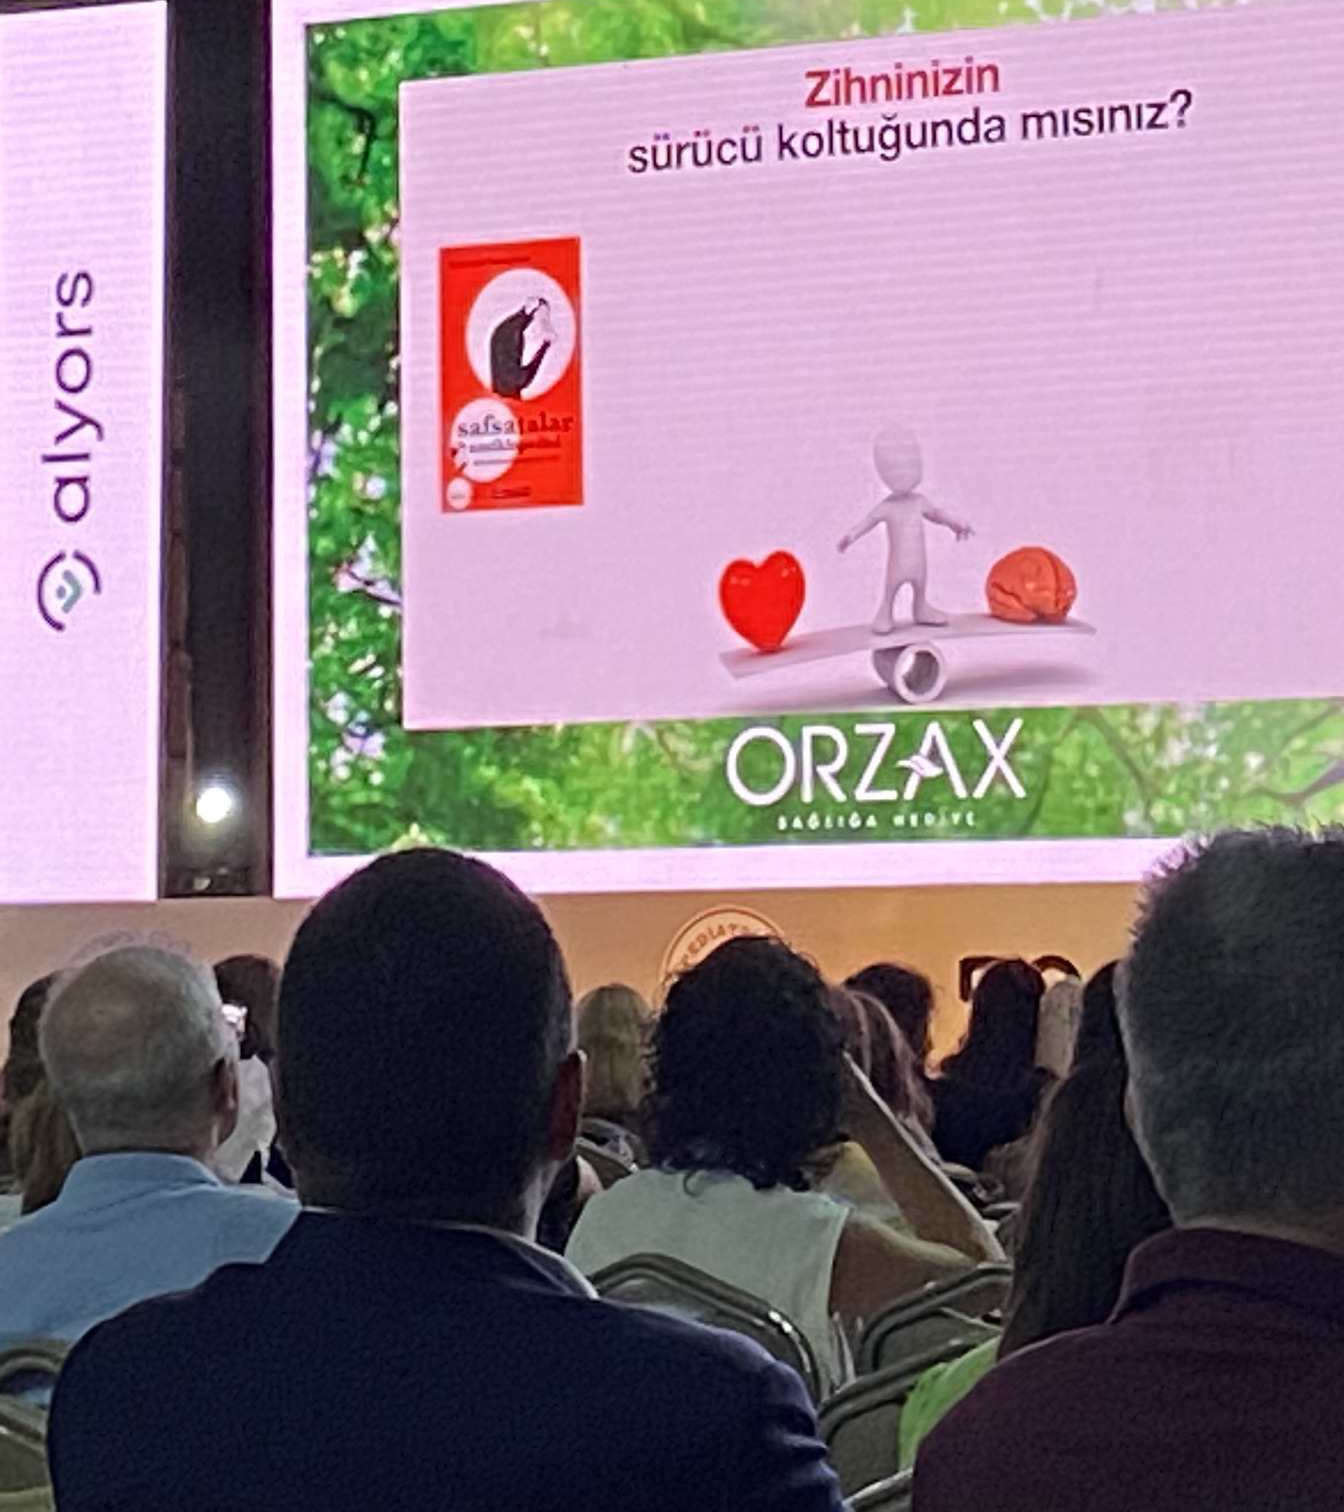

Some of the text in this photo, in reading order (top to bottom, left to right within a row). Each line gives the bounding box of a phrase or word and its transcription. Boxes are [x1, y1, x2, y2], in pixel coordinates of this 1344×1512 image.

[804, 56, 1000, 109] Zihninizin
[628, 89, 1193, 174] sürücü koltuğunda mısınız?
[41, 271, 104, 524] alyors
[726, 717, 1027, 806] ORZAX
